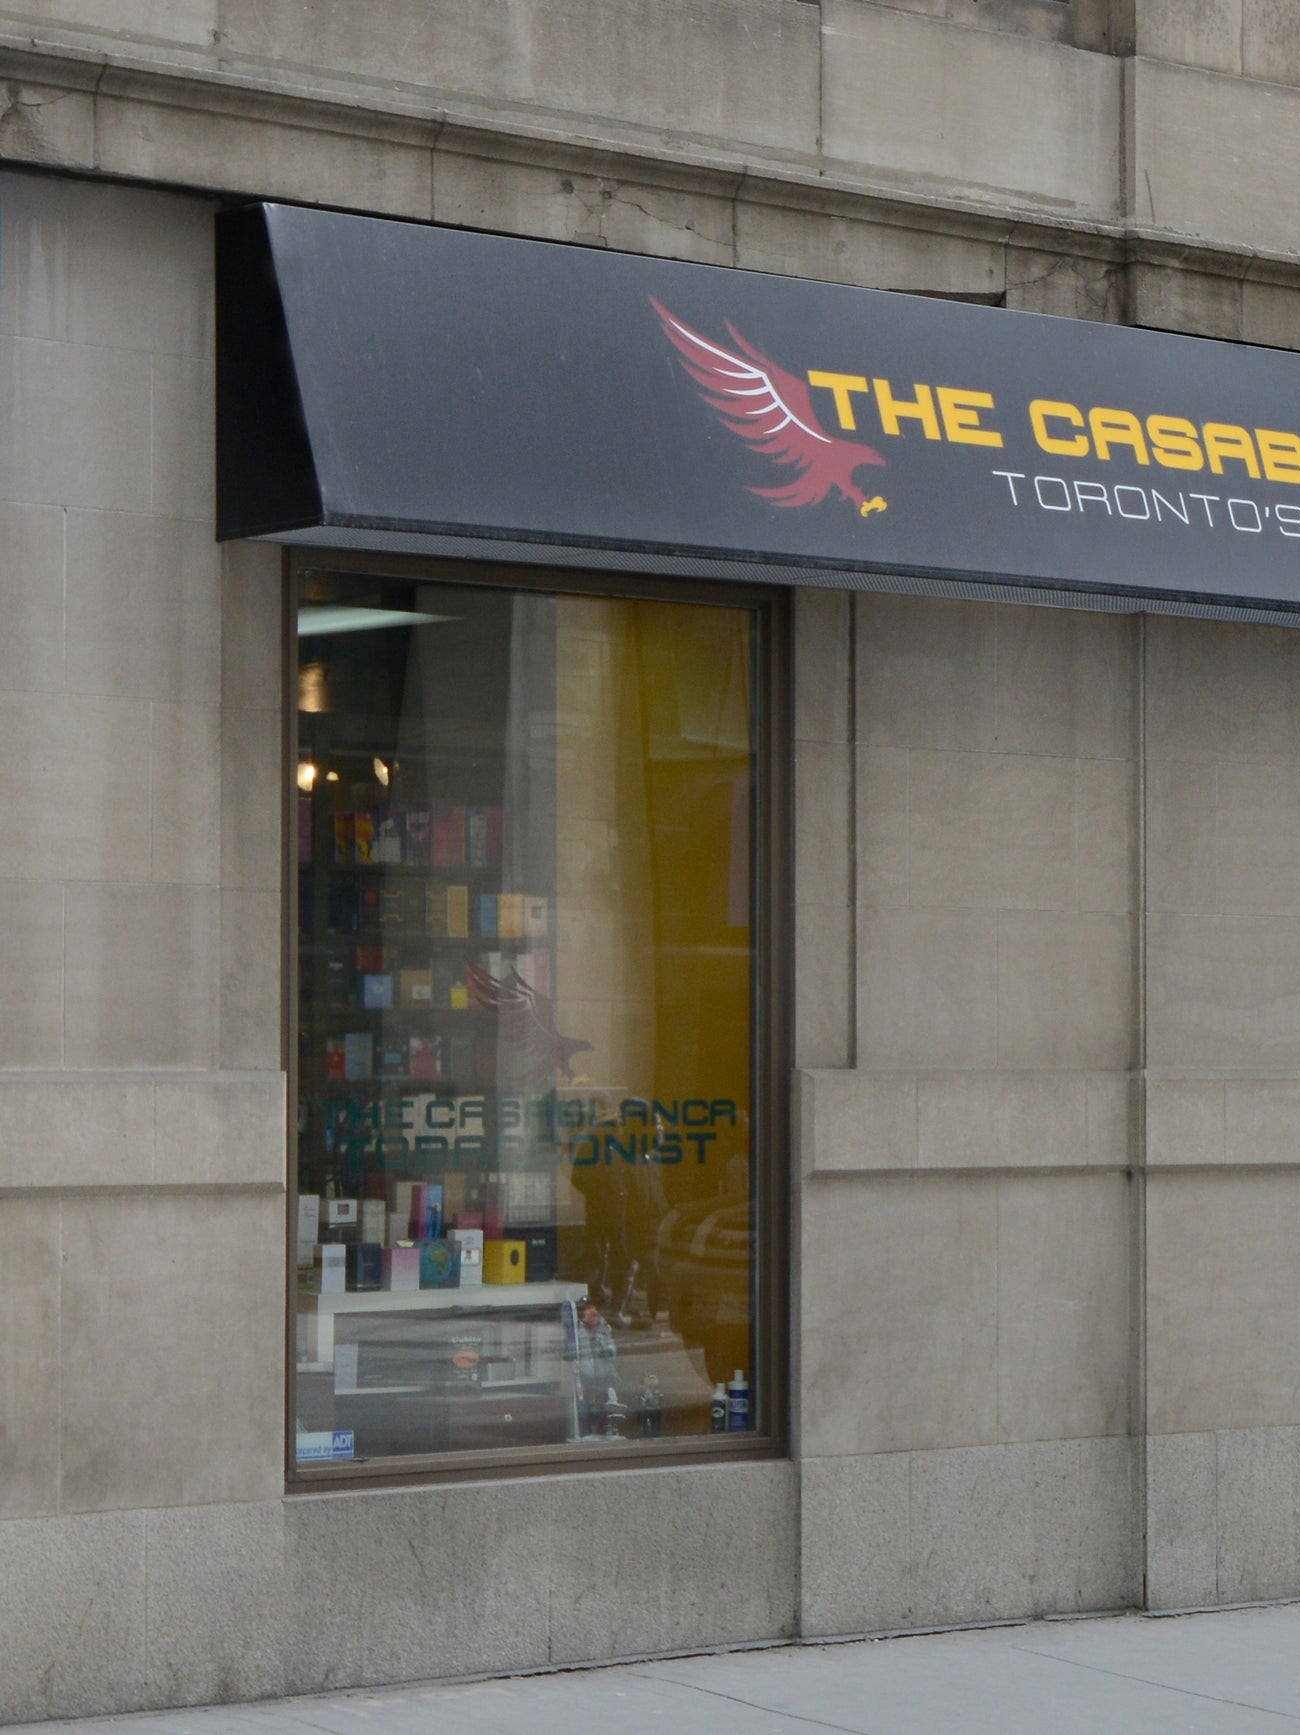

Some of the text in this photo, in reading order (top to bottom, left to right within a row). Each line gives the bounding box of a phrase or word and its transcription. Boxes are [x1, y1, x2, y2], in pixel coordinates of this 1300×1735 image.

[808, 369, 1004, 448] THE
[317, 1097, 737, 1130] THE CASABLANCA
[333, 1434, 353, 1449] ADT
